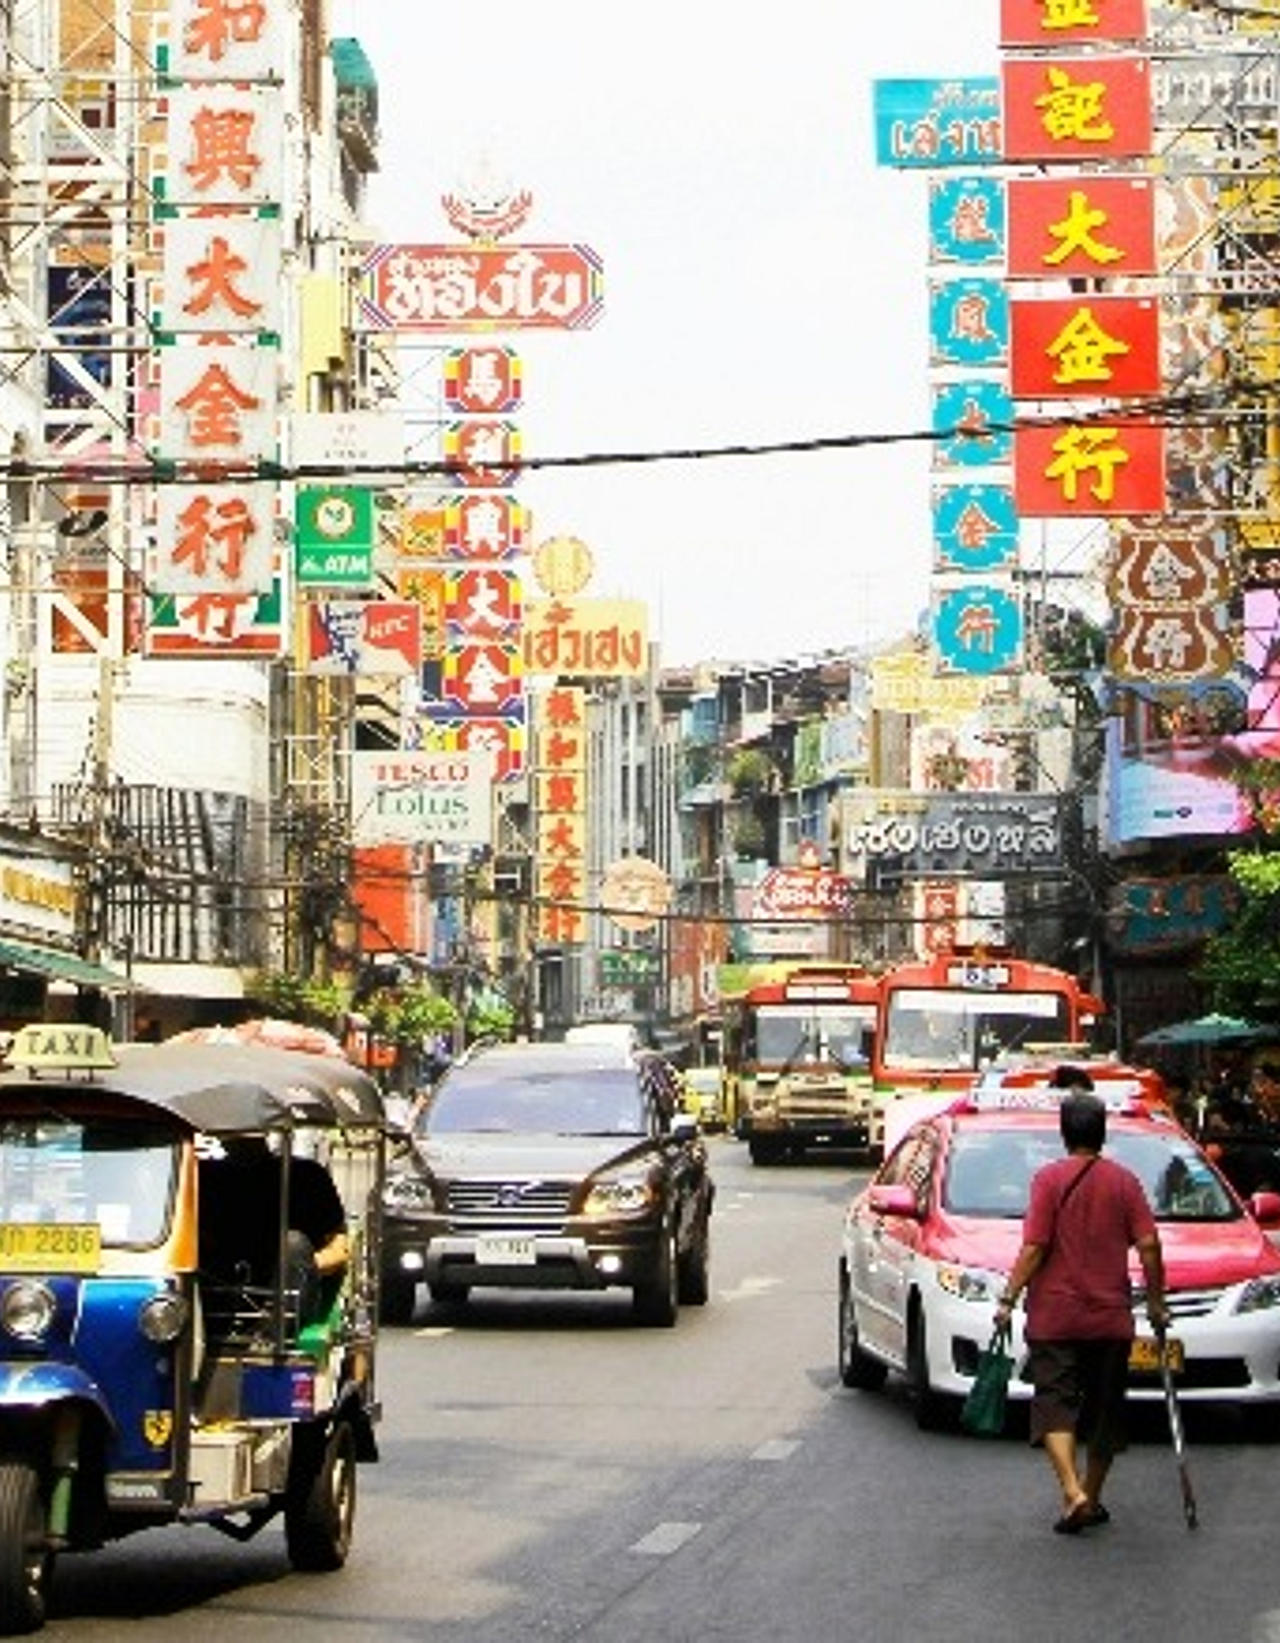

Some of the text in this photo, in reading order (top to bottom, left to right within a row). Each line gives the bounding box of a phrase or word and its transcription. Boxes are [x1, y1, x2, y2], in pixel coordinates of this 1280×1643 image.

[324, 554, 368, 575] ATM
[370, 614, 410, 640] KFC
[371, 764, 469, 781] TESCO
[25, 1030, 95, 1056] TAXI
